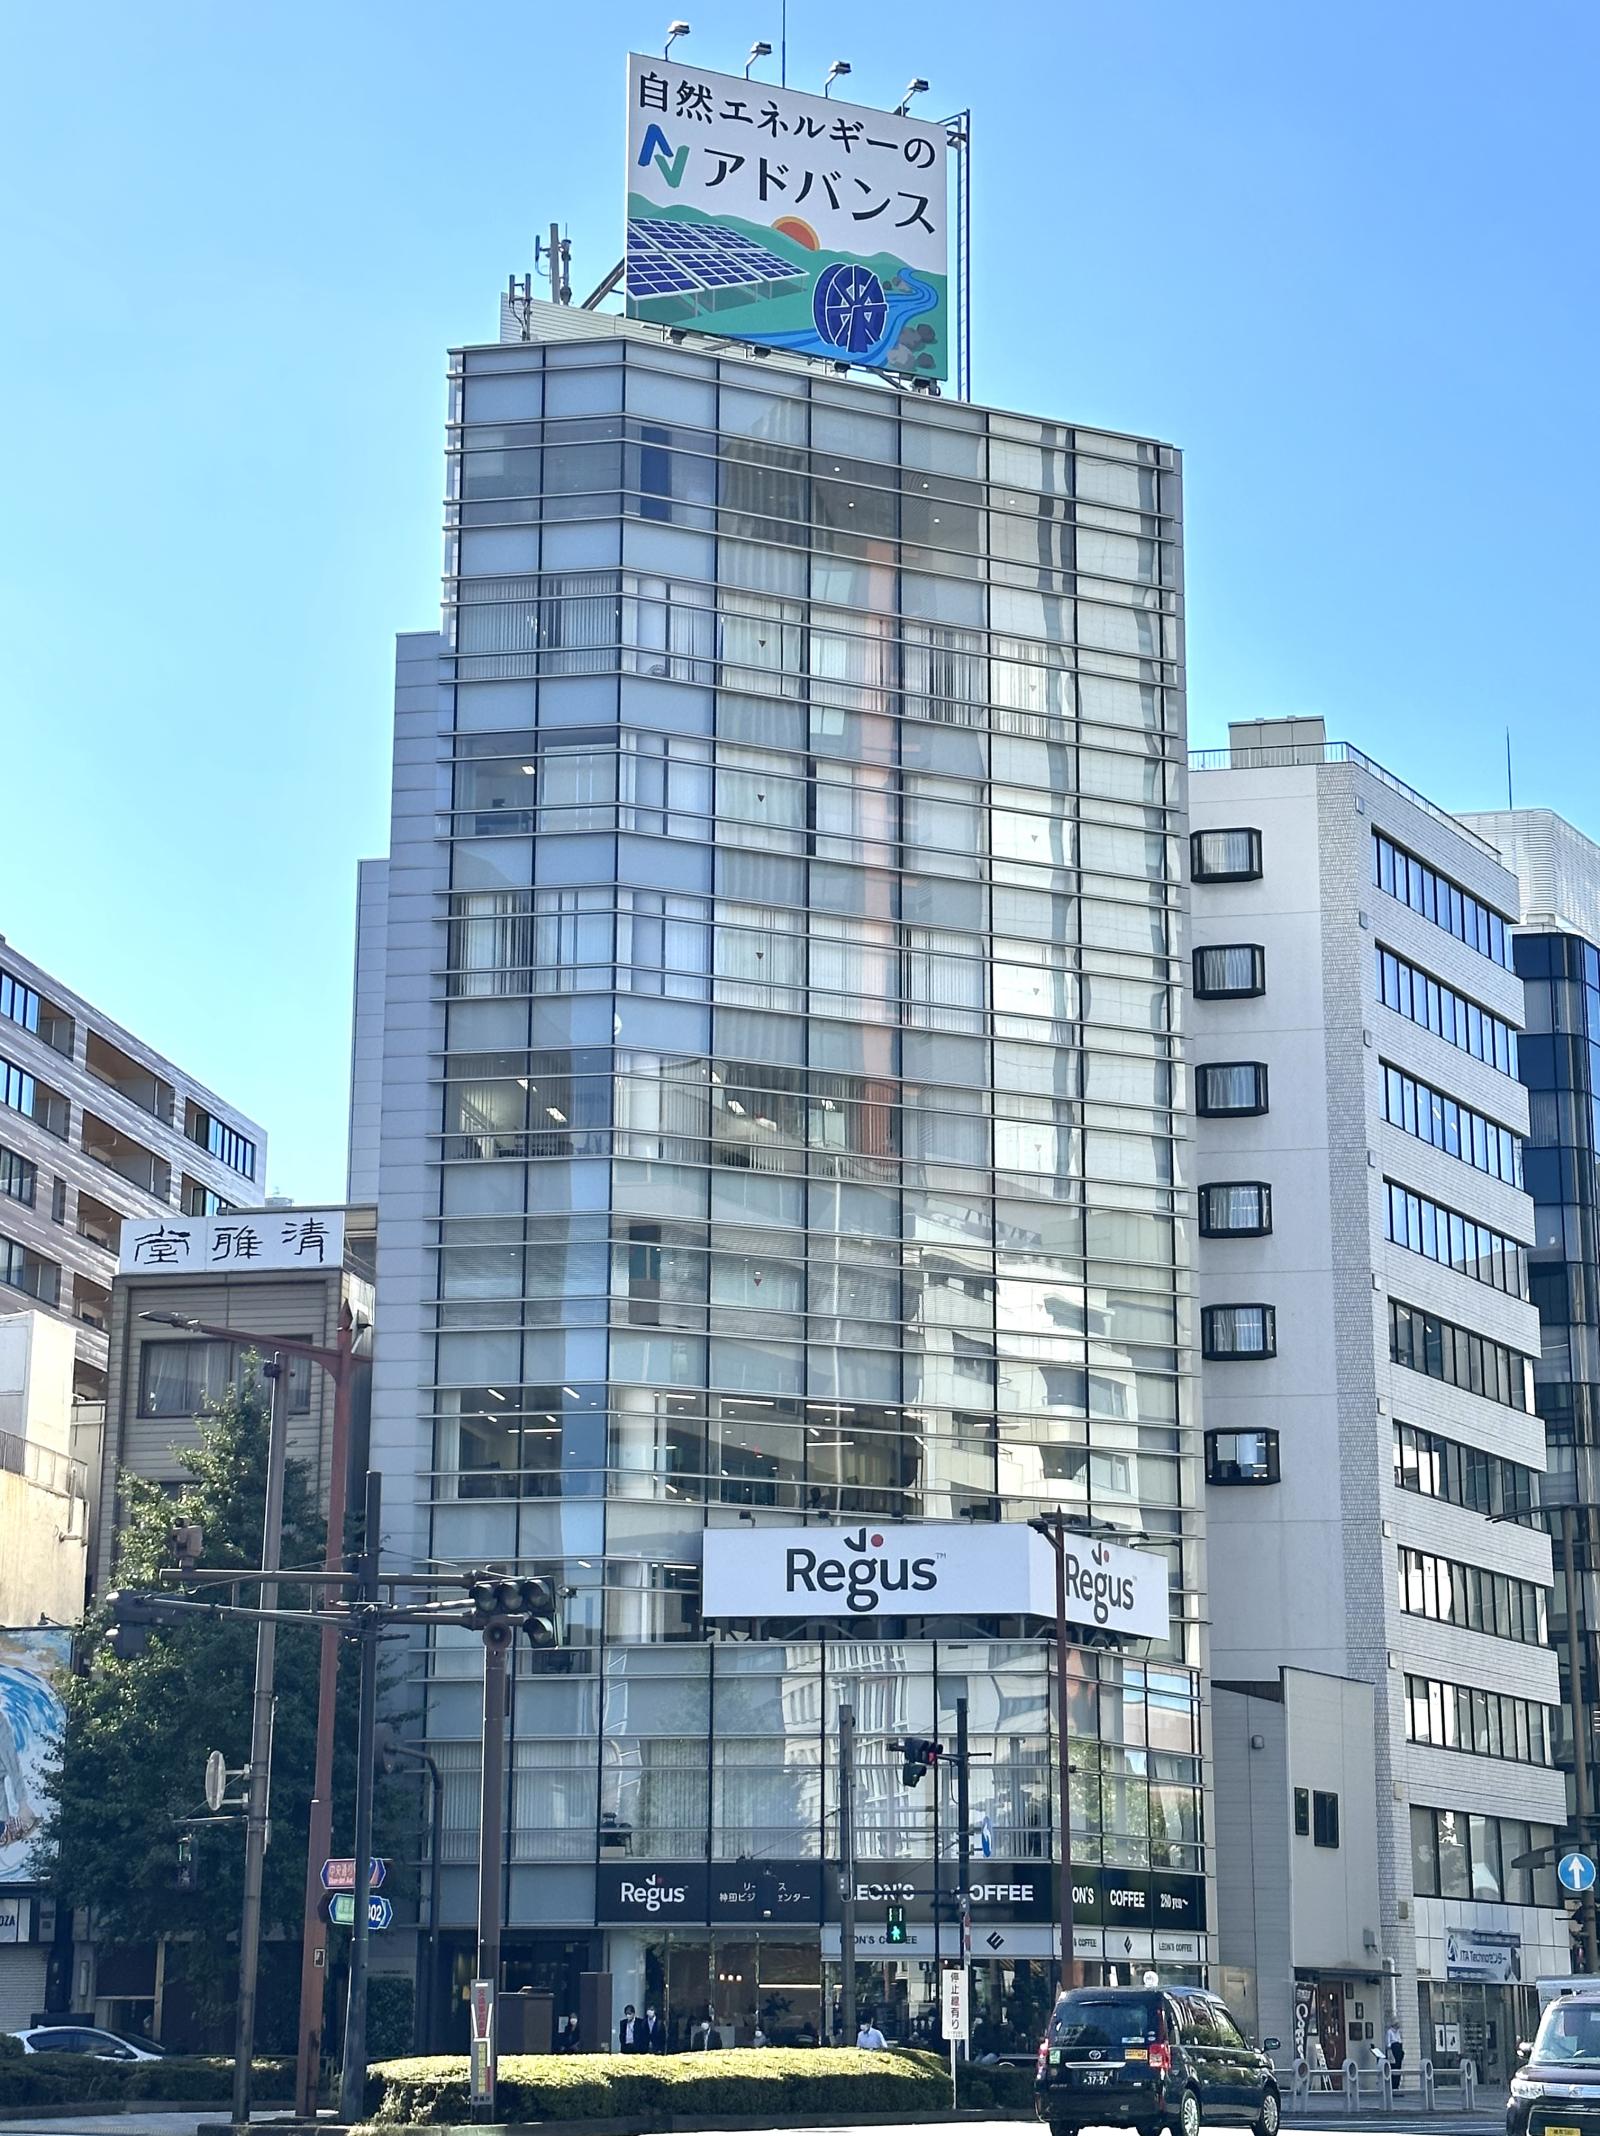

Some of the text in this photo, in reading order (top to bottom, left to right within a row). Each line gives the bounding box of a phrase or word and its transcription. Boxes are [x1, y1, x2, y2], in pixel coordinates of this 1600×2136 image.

[638, 71, 936, 169] 自然エネルギーの
[703, 147, 936, 235] アドバンス
[786, 1547, 938, 1613] Regus
[1065, 1552, 1135, 1625] Regus
[368, 1903, 382, 1922] 02
[620, 1881, 686, 1912] Regus
[853, 1882, 1034, 1901] EON'S OFFEE
[1109, 1889, 1145, 1908] COFFEE
